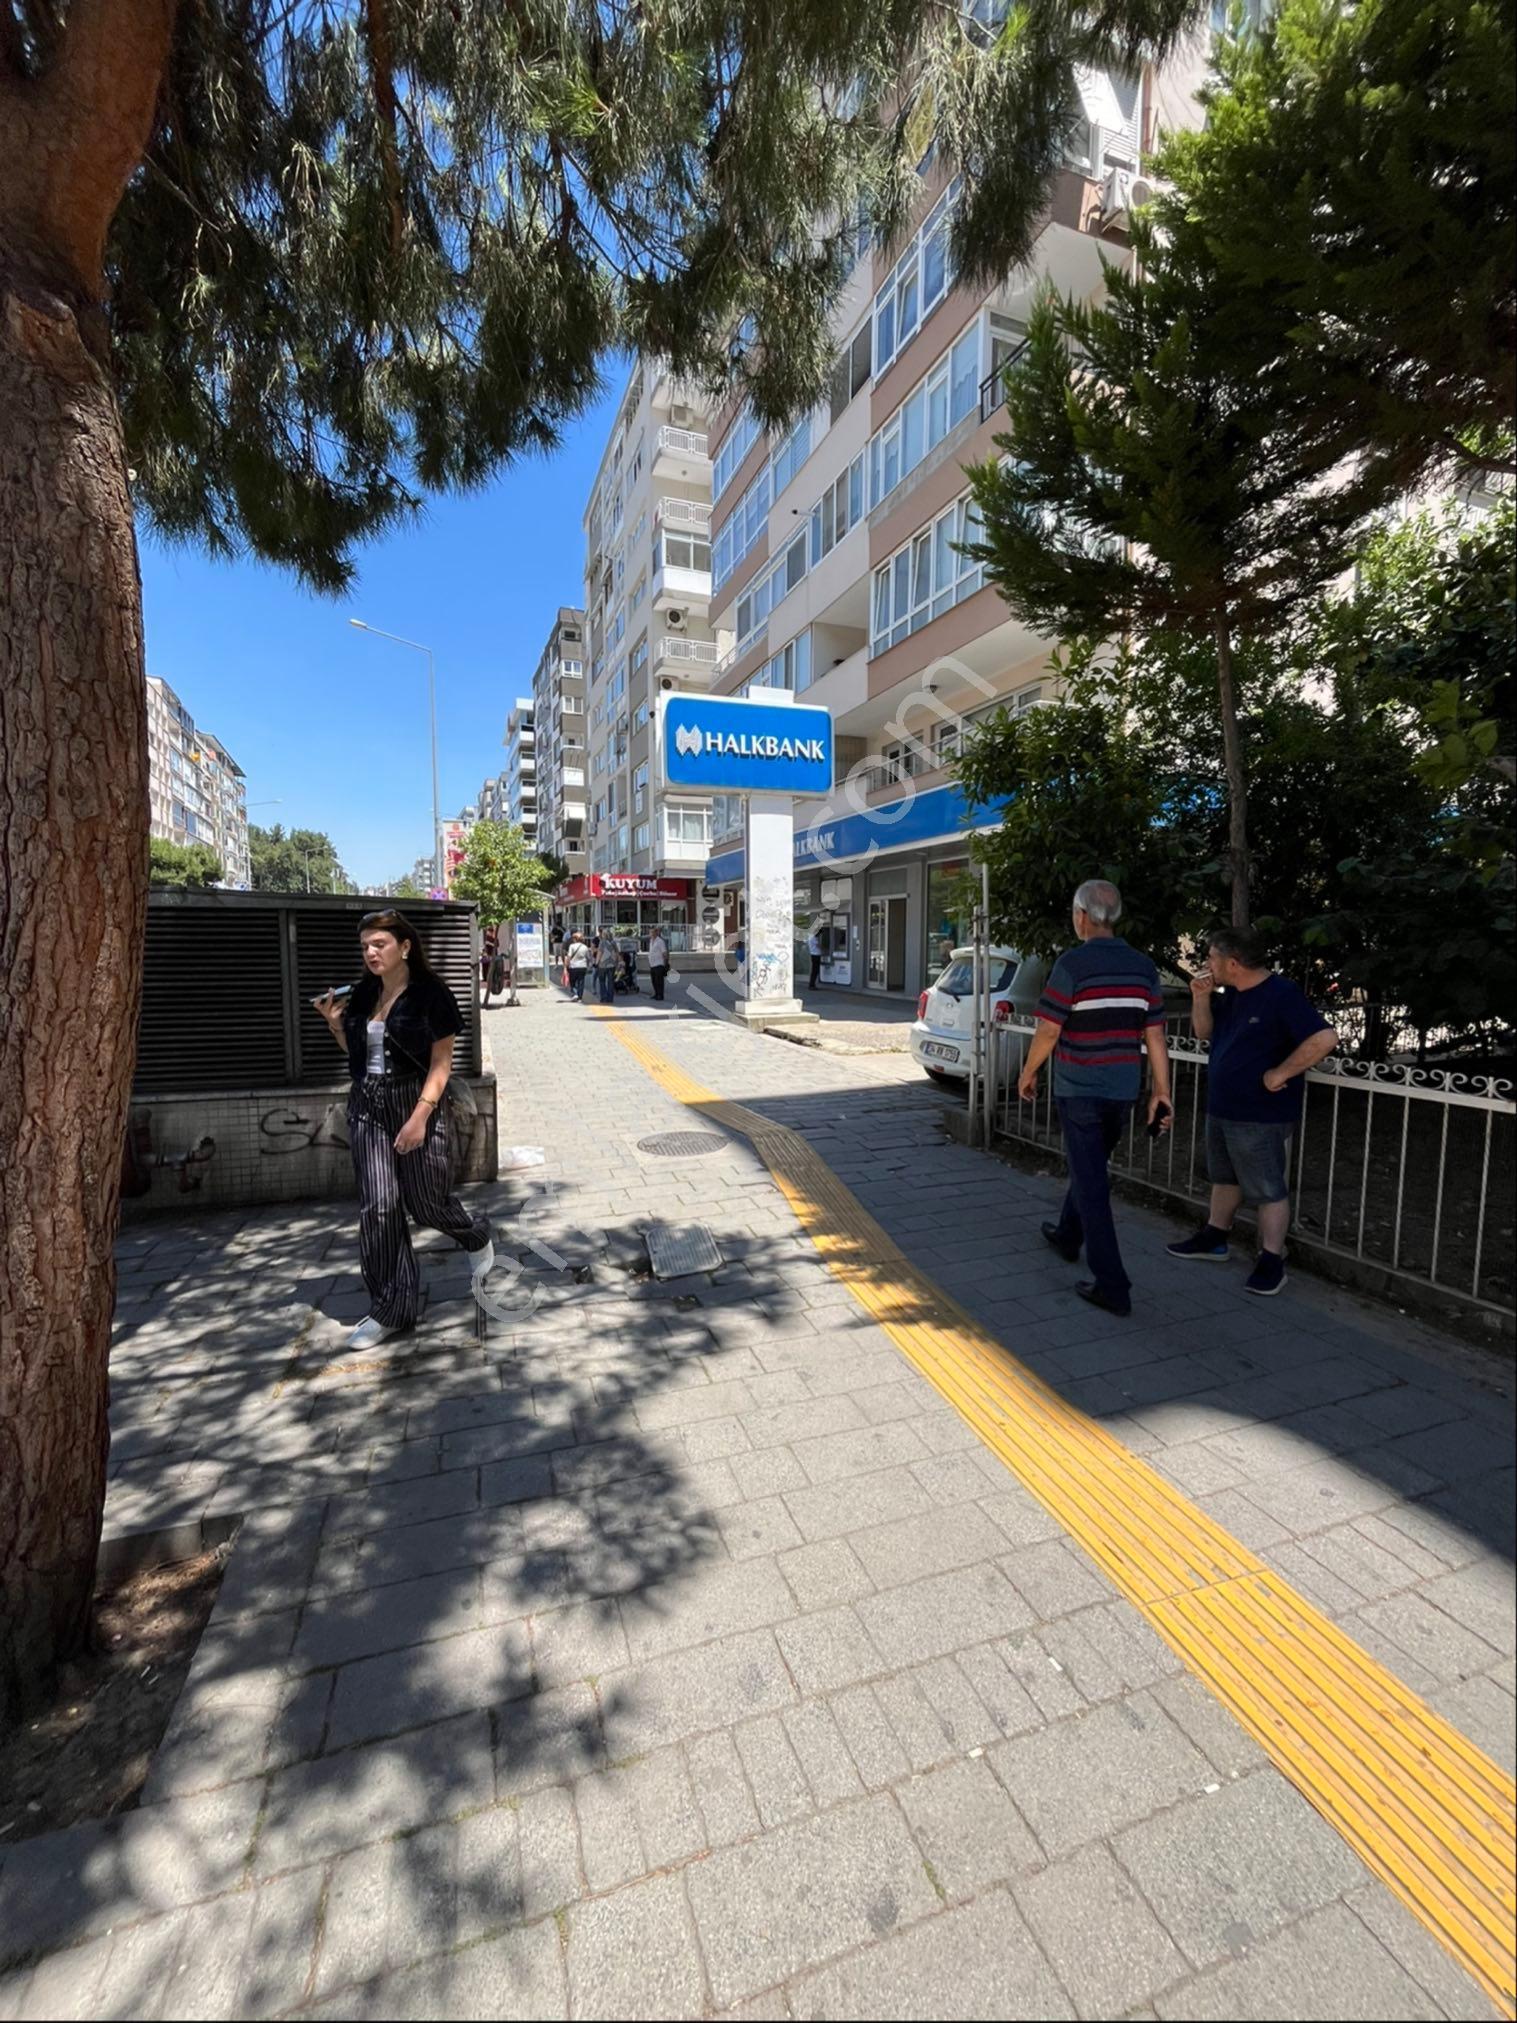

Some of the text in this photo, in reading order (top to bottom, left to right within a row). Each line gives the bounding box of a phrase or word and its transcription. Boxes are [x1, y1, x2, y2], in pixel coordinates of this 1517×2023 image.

[705, 731, 826, 760] HALKBANK
[795, 831, 836, 857] LKBANK
[604, 876, 658, 890] KUYUM
